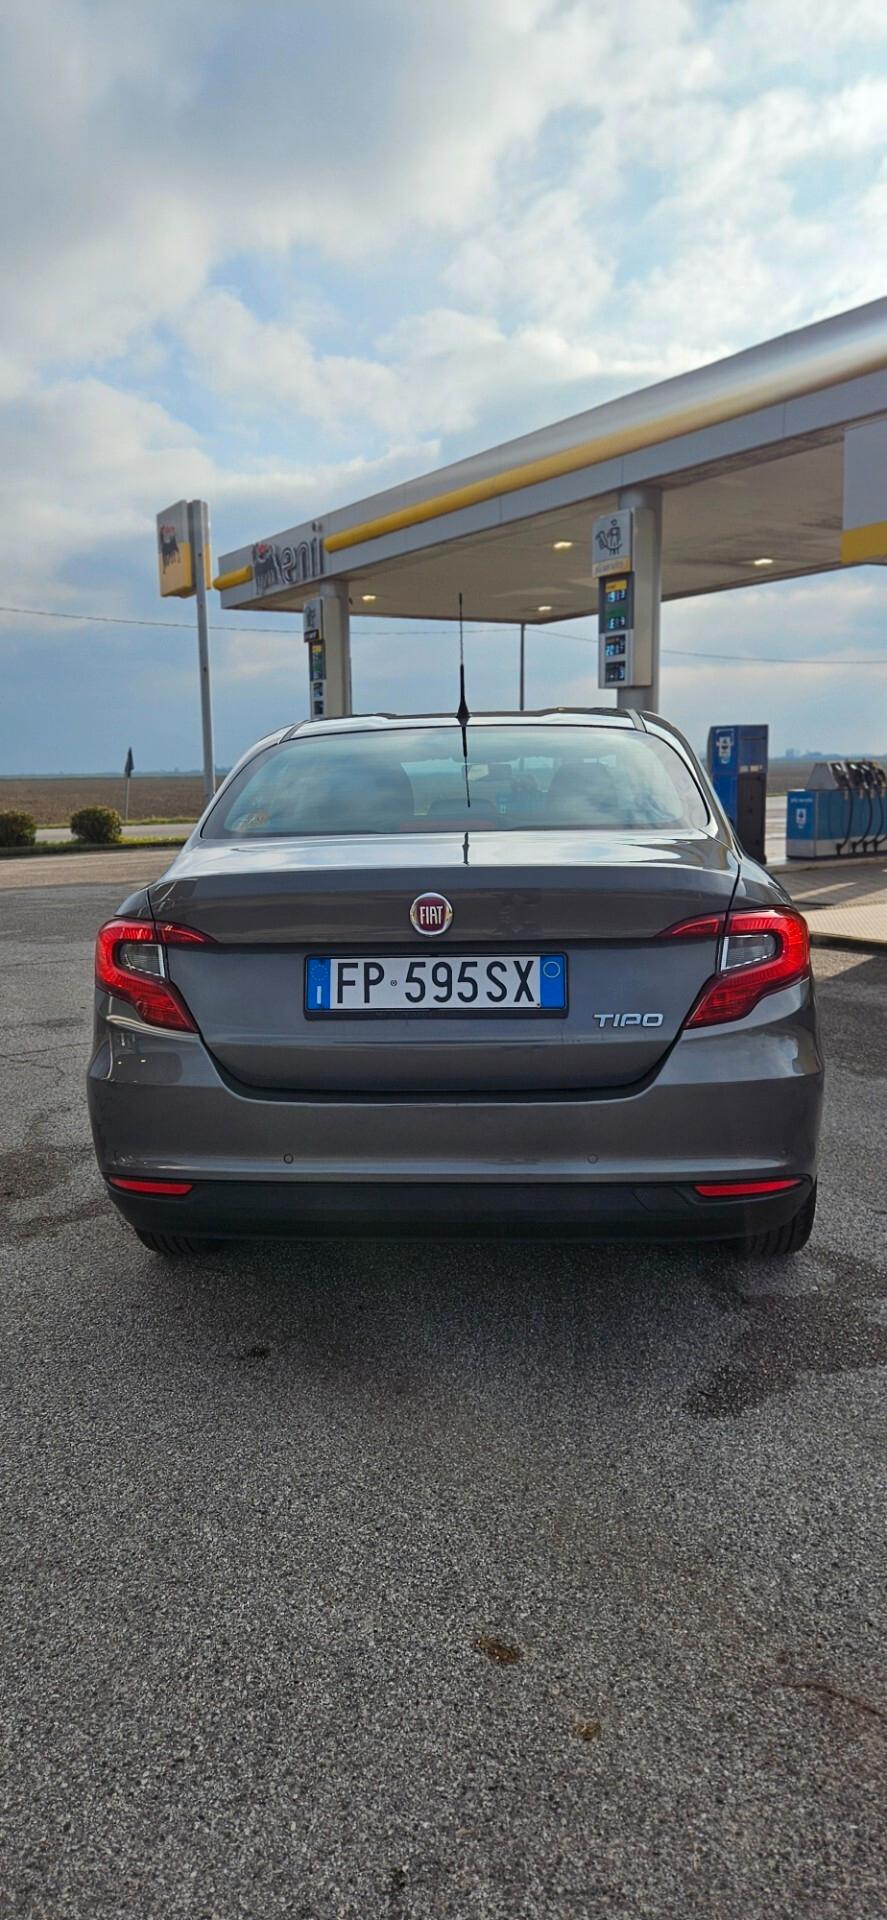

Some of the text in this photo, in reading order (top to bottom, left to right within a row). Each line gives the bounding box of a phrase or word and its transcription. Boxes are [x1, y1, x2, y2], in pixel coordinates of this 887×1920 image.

[280, 521, 324, 585] eni
[419, 906, 444, 925] FIAT
[337, 962, 385, 1004] FP
[593, 1012, 664, 1028] TIPO
